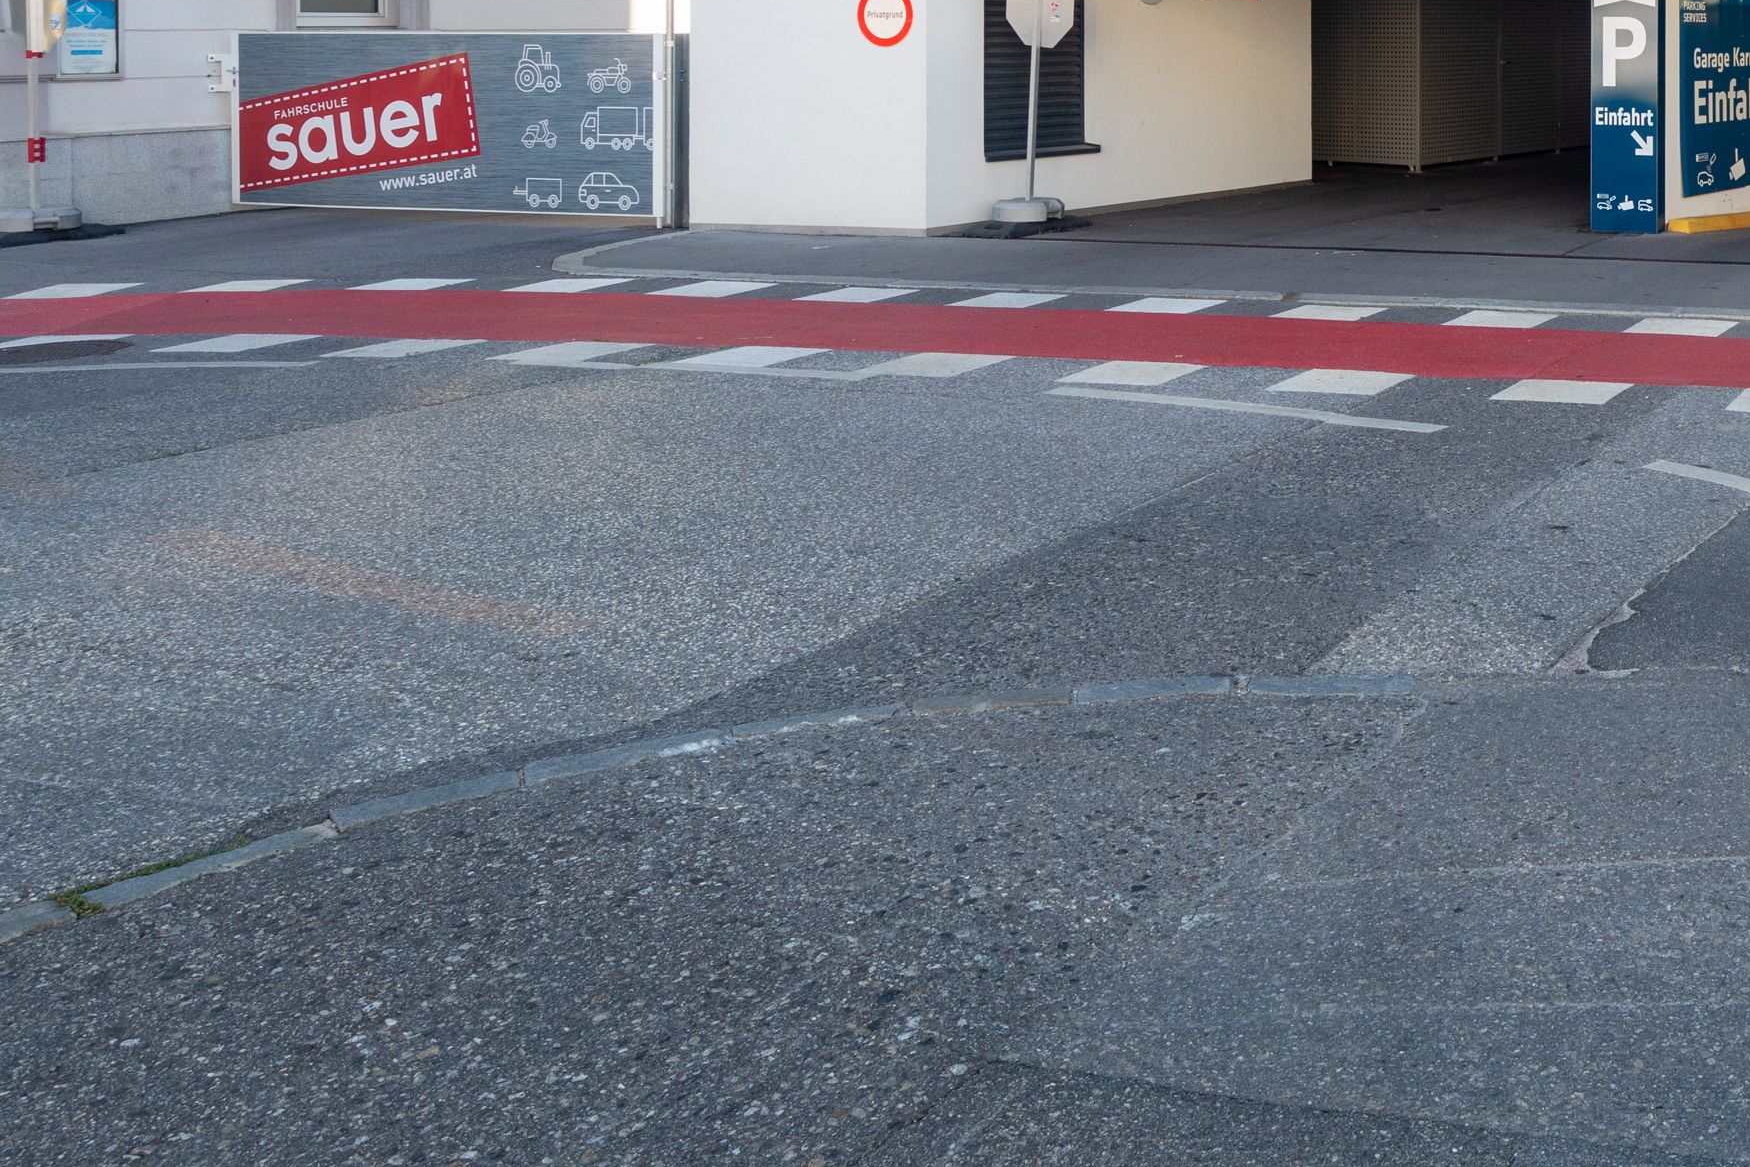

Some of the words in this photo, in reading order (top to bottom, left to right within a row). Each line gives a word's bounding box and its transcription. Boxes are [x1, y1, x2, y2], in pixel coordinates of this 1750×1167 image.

[867, 10, 904, 20] Privatgrund
[1683, 0, 1706, 11] PARKING
[1683, 12, 1707, 23] SERVICES
[1603, 16, 1647, 87] P
[1693, 47, 1730, 73] Garage
[273, 97, 348, 120] FAHRSCHULE
[1595, 106, 1654, 127] Einfahrt
[266, 92, 442, 171] sauer
[379, 163, 478, 191] www.sauer.at
